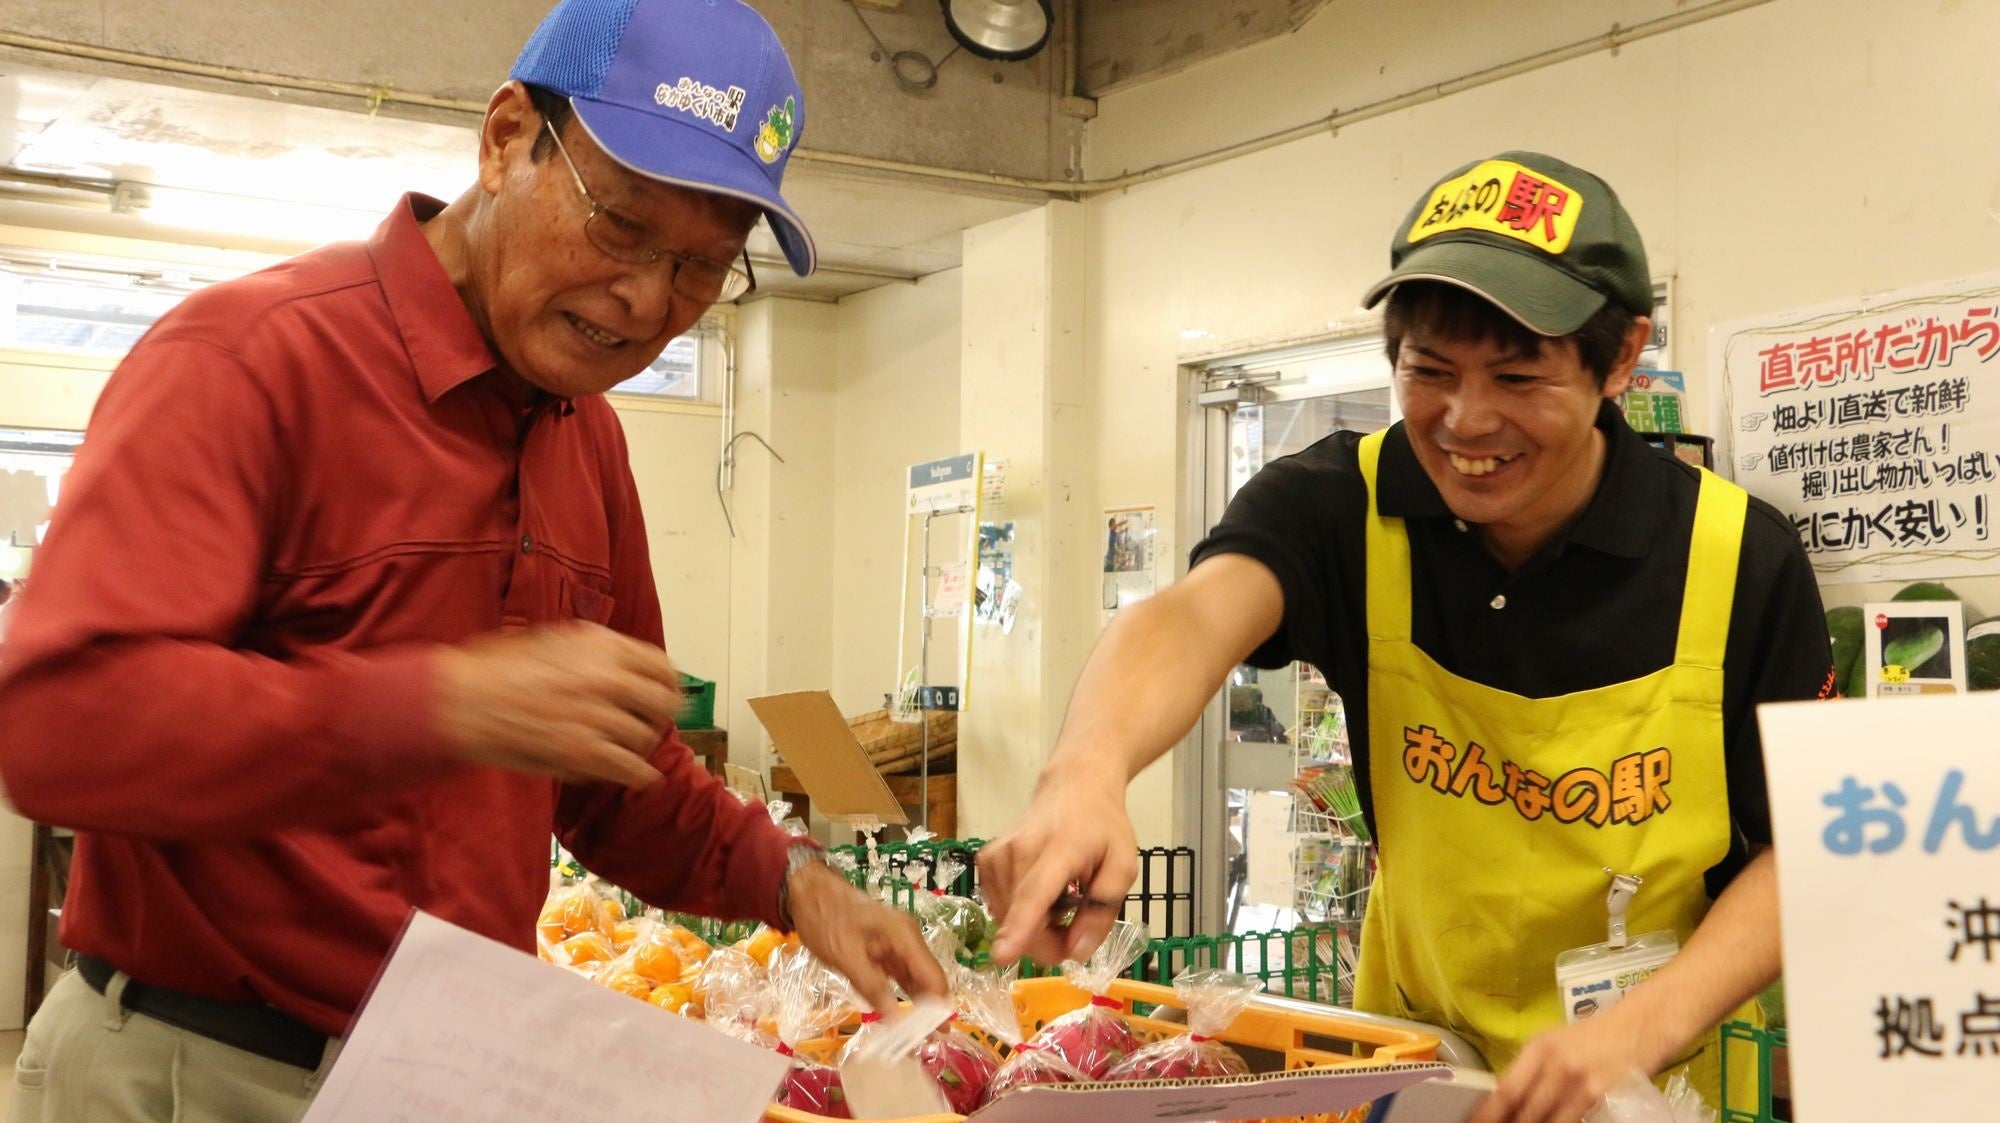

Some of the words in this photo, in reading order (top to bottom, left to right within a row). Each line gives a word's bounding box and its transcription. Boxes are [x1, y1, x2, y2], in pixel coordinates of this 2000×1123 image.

[677, 77, 746, 114] おんなの駅
[1422, 170, 1569, 243] おんなの駅
[1757, 307, 2000, 394] 直売所だから
[1772, 376, 1969, 433] 畑より直送で新鮮
[1802, 450, 2000, 499] 掘り出し物がいっぱい
[1403, 724, 1672, 829] おんなの駅
[1821, 769, 2000, 856] おん
[1874, 993, 2000, 1059] 拠点
